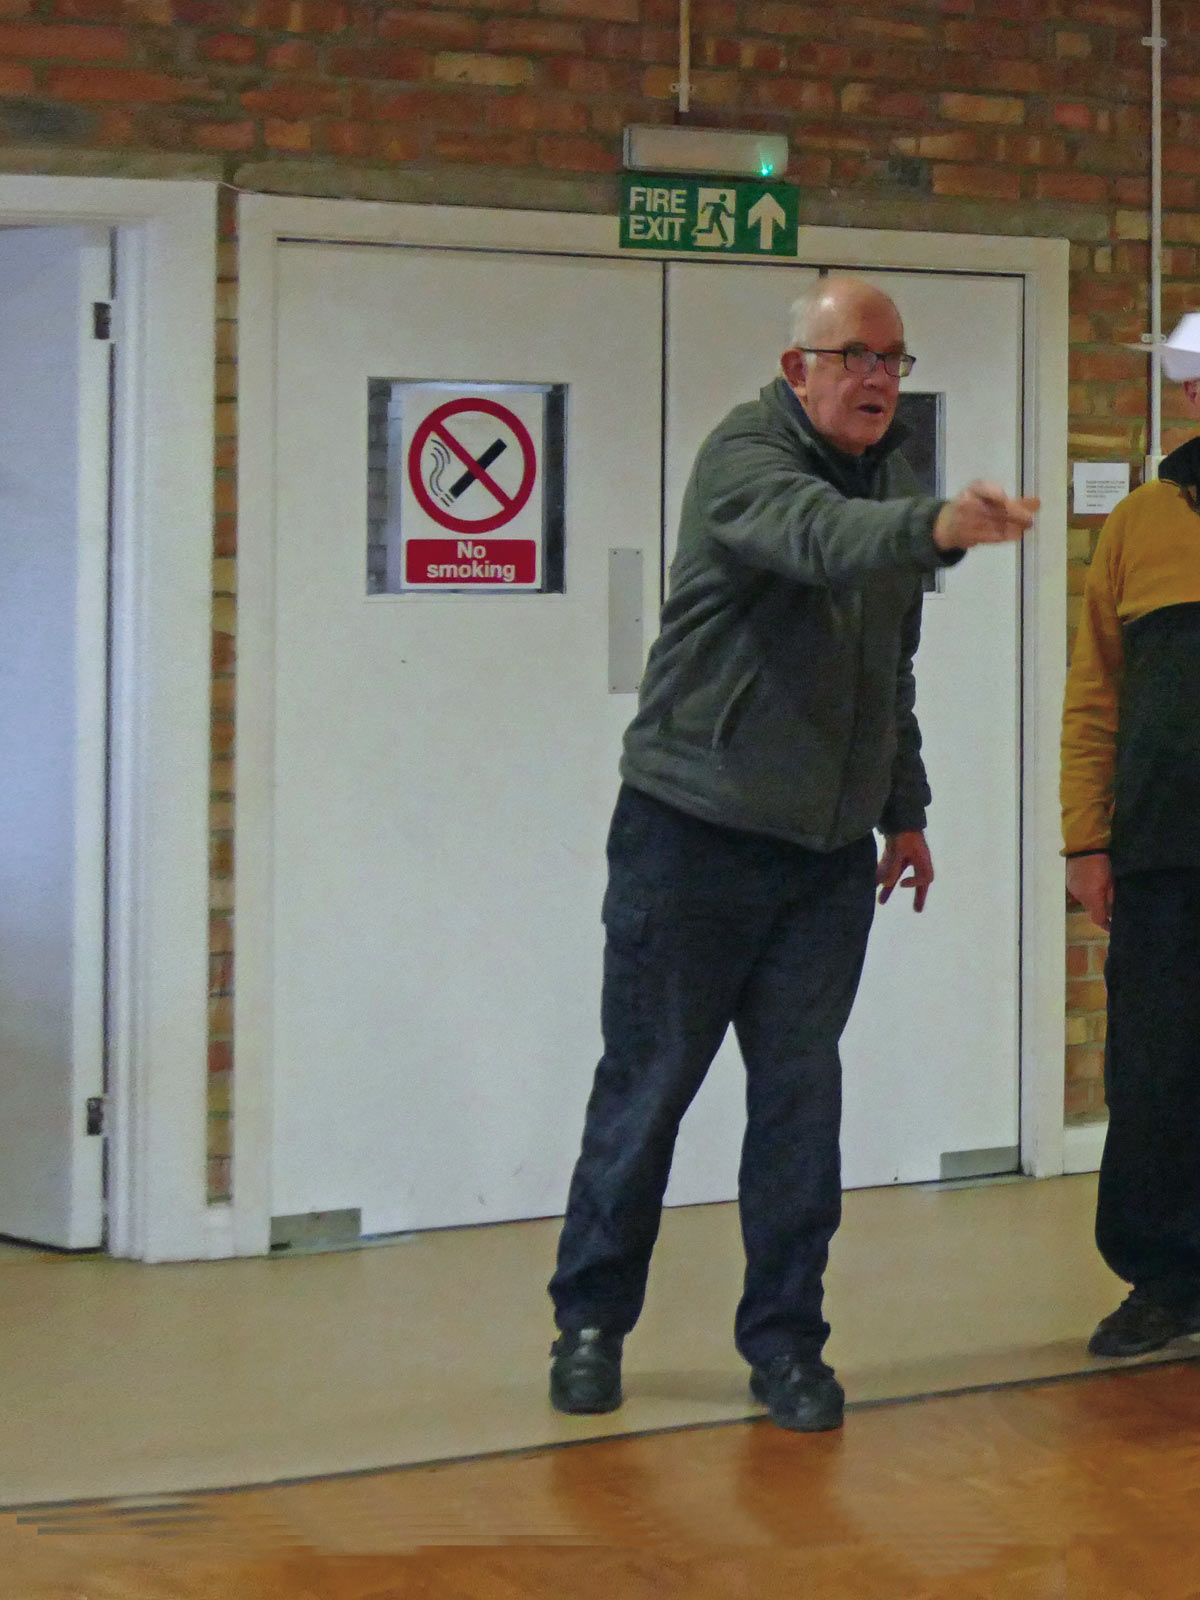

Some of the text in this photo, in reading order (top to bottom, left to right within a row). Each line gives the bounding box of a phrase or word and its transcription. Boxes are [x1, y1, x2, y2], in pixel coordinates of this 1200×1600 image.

[629, 186, 687, 214] FIRE
[629, 214, 686, 242] EXIT
[457, 541, 487, 559] No
[426, 560, 516, 582] smoking
